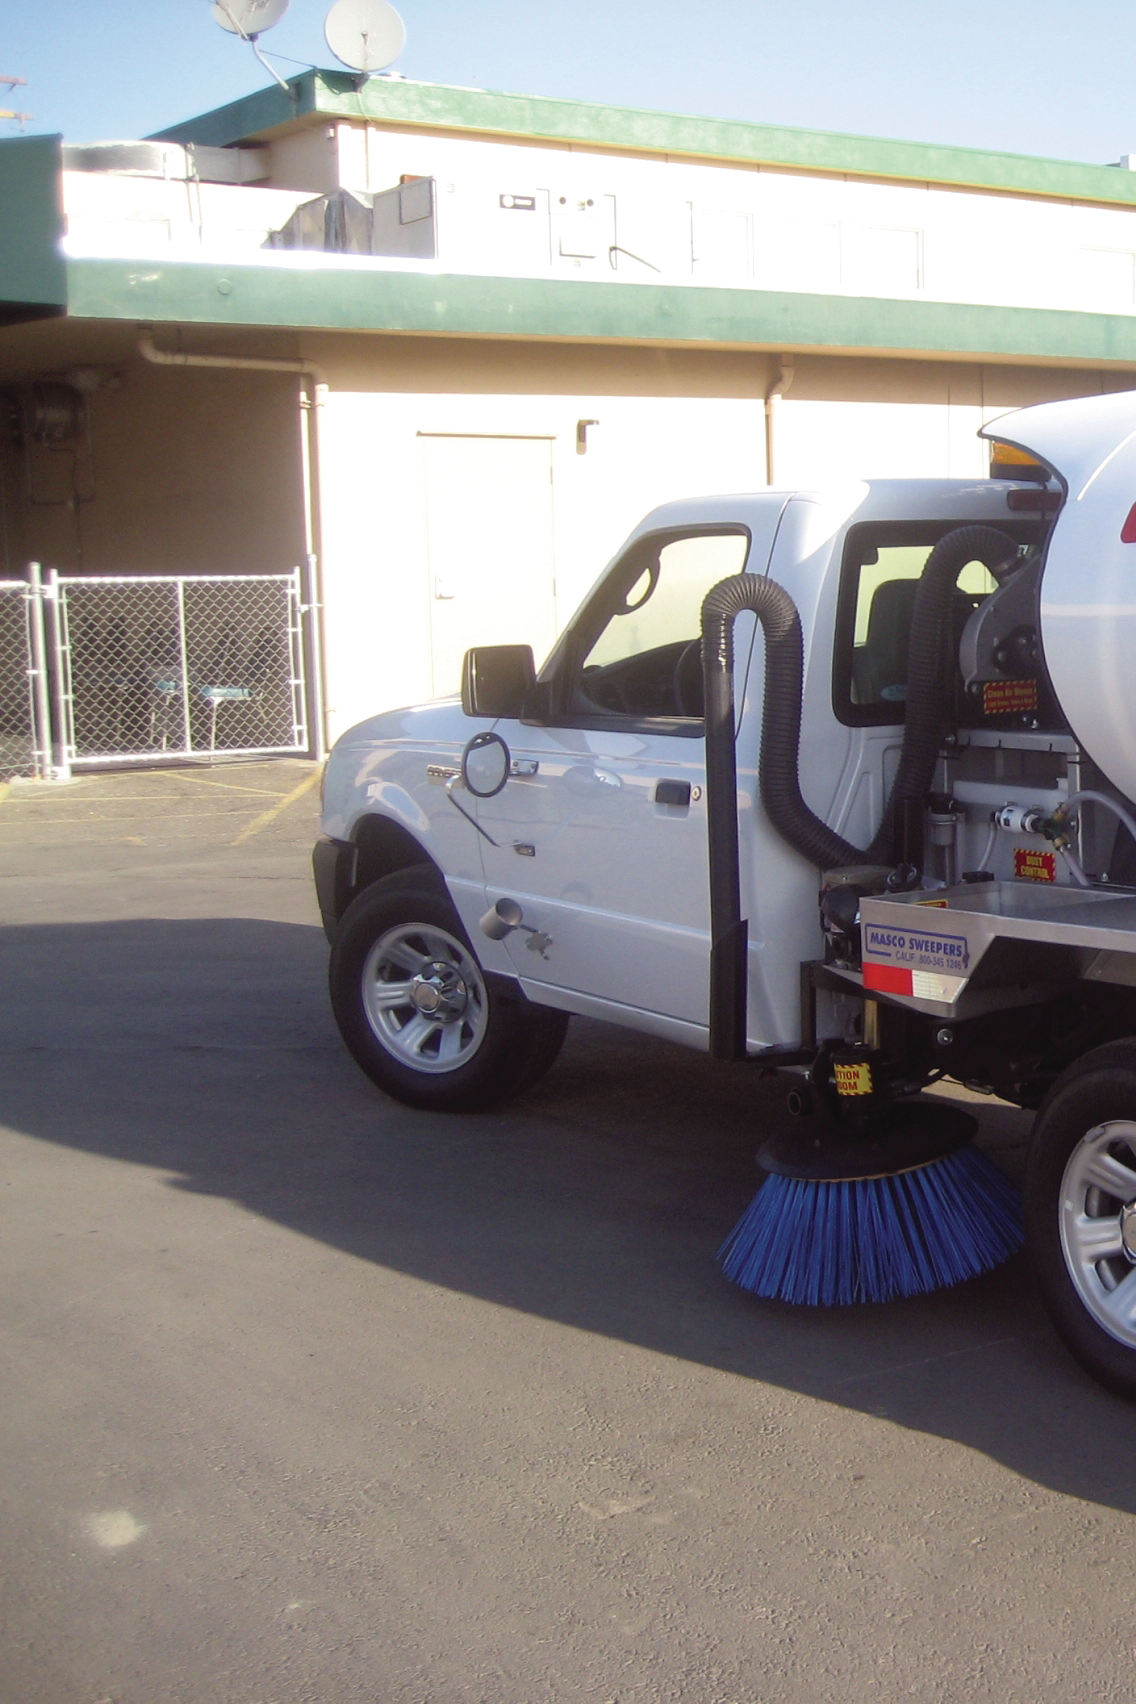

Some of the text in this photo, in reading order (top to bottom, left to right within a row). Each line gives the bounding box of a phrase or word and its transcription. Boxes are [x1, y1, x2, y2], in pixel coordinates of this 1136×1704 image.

[1027, 856, 1042, 866] DUST
[1021, 866, 1049, 878] CONTROL
[870, 932, 962, 957] MASCO SWEEPERS
